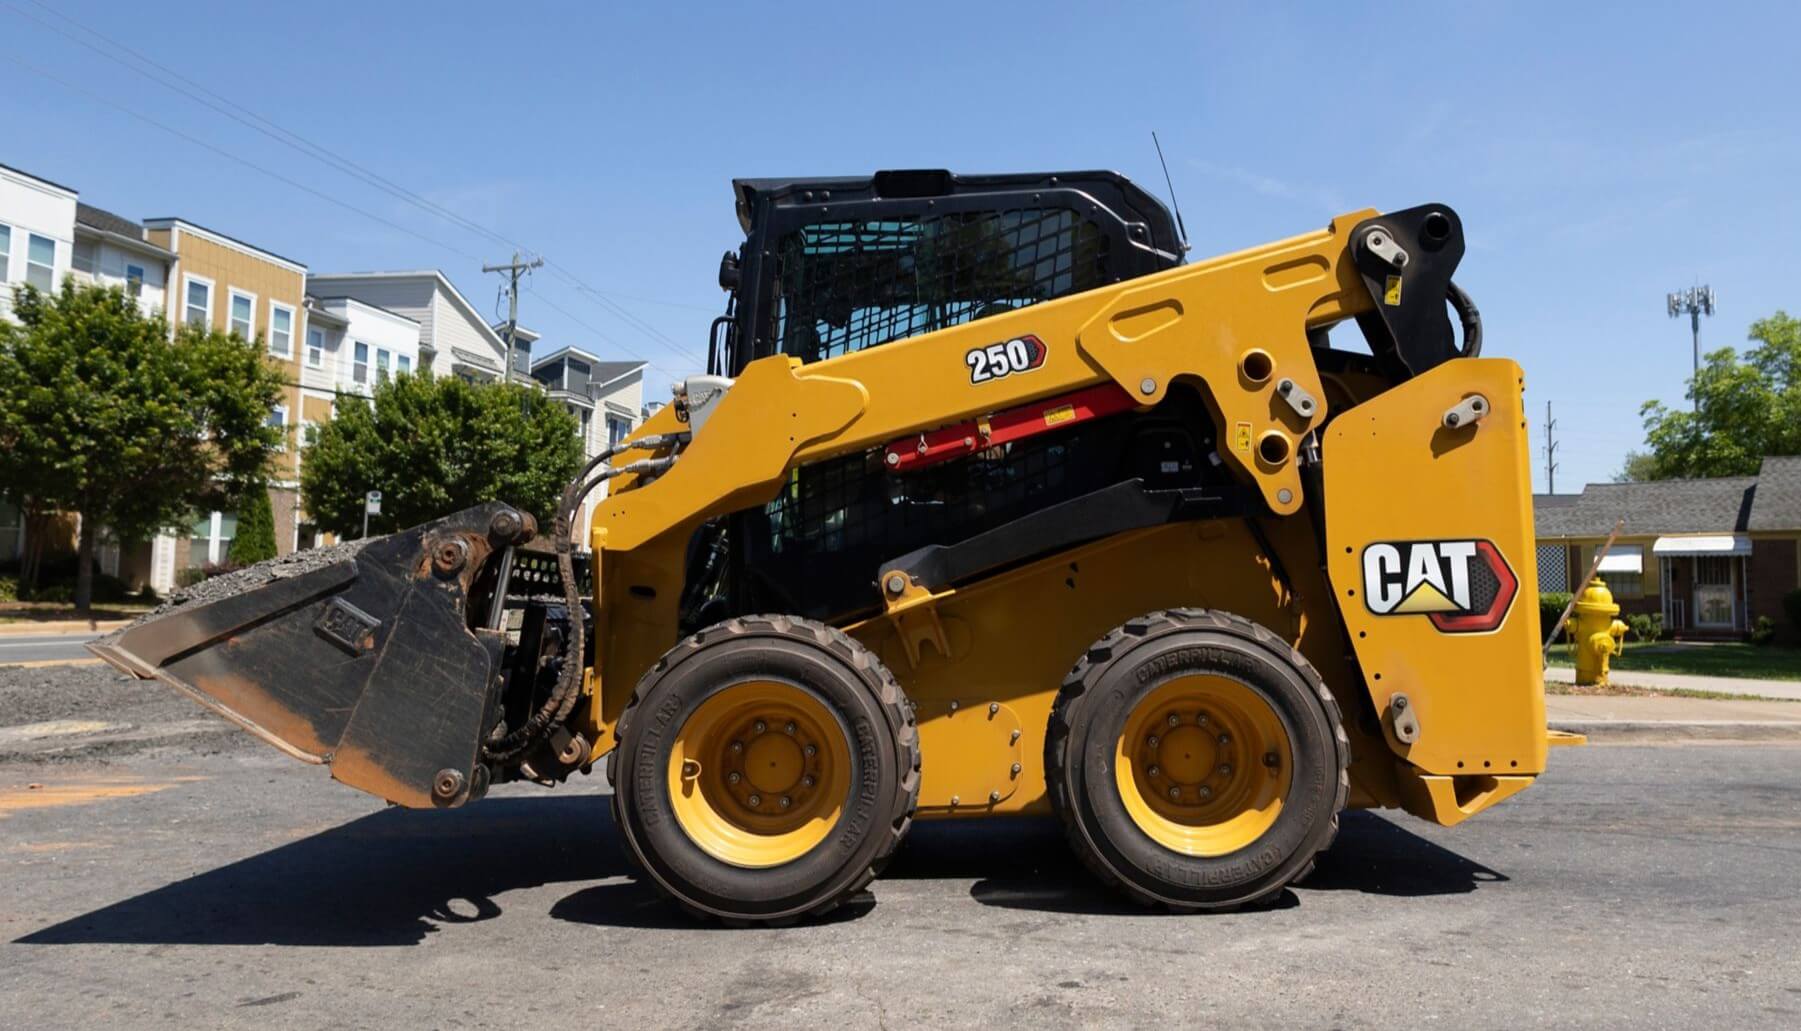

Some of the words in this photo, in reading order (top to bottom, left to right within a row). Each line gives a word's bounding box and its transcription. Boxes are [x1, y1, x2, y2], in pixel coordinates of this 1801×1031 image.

[967, 338, 1029, 382] 250
[1364, 541, 1477, 614] CAT
[1135, 648, 1260, 682] CATERPILLAR
[639, 697, 679, 825] CATERPILLAR
[840, 721, 879, 850] CATERPILLAR
